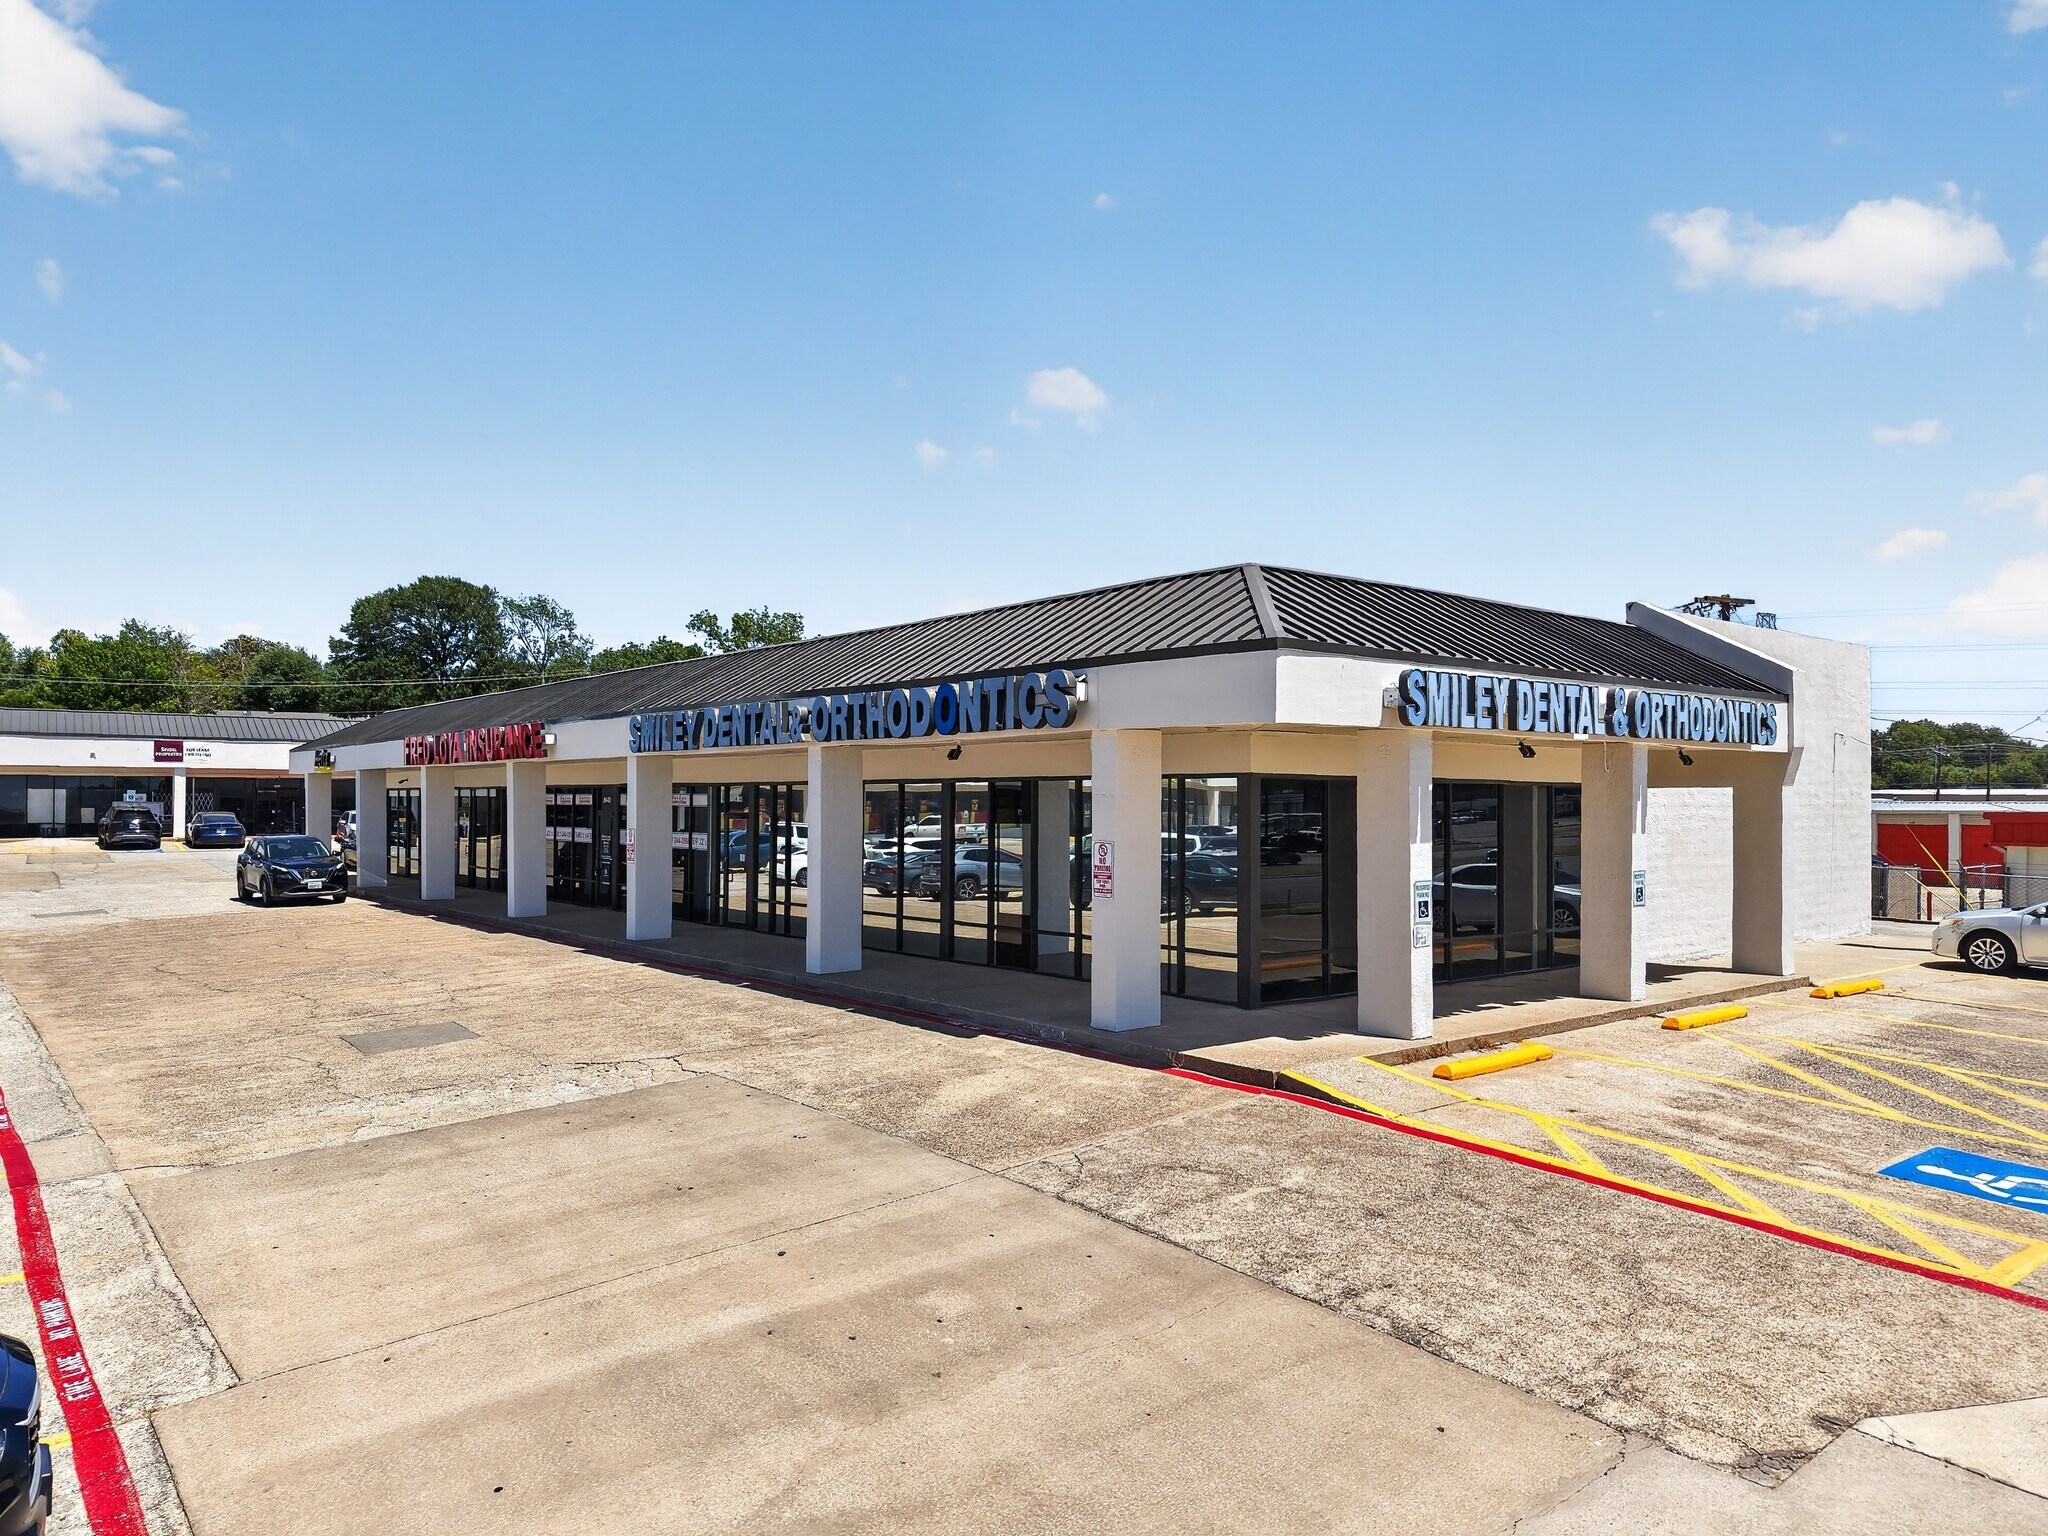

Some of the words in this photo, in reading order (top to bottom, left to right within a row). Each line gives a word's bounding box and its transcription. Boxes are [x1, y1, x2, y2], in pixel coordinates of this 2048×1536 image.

[629, 709, 700, 753] SMILEY
[702, 700, 789, 749] DENTAL
[789, 704, 809, 741] &
[810, 669, 1077, 743] ORTHODONTICS
[1401, 668, 1509, 730] SMILEY
[1517, 679, 1607, 736] DENTAL
[1608, 687, 1629, 737] &
[1629, 691, 1777, 746] ORTHODONTICS
[404, 735, 430, 765] FRED
[433, 732, 462, 764] LOYA
[464, 722, 546, 763] INSURANCE
[39, 1298, 69, 1327] PARKING
[48, 1326, 74, 1341] NO
[56, 1352, 86, 1379] LANE
[63, 1377, 95, 1402] FIRE
